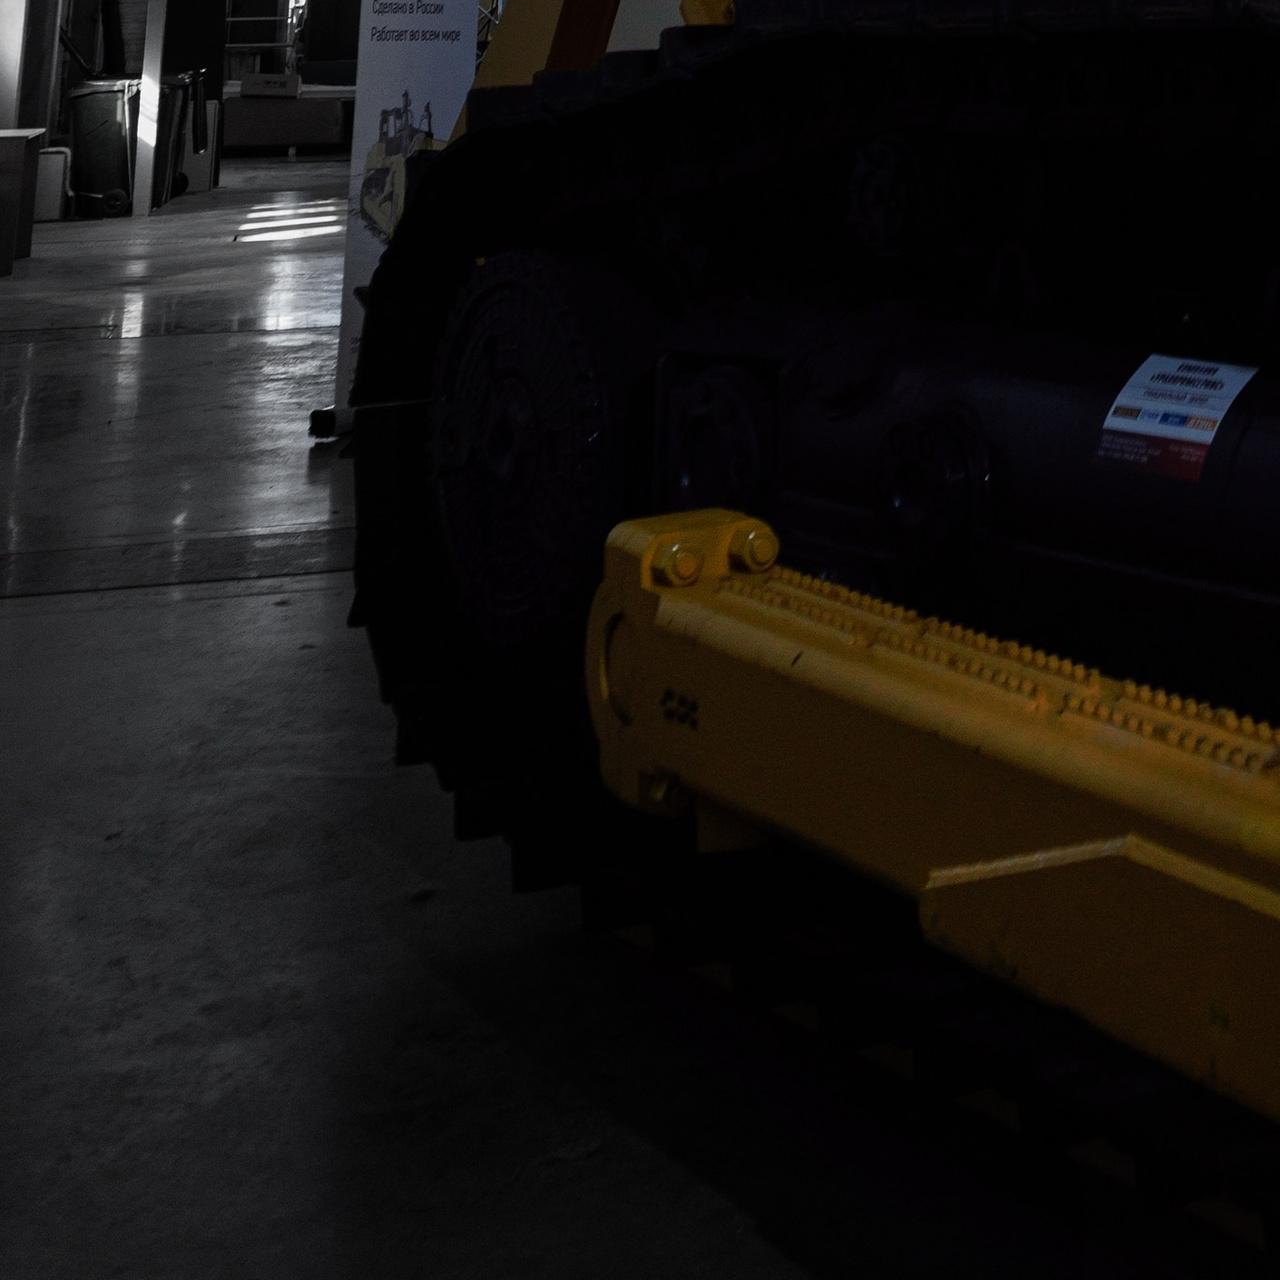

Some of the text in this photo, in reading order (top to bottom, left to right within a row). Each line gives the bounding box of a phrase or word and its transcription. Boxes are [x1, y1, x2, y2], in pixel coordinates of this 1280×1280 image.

[408, 3, 414, 15] в
[416, 0, 444, 15] России
[371, 26, 462, 44] Работает во всем мире
